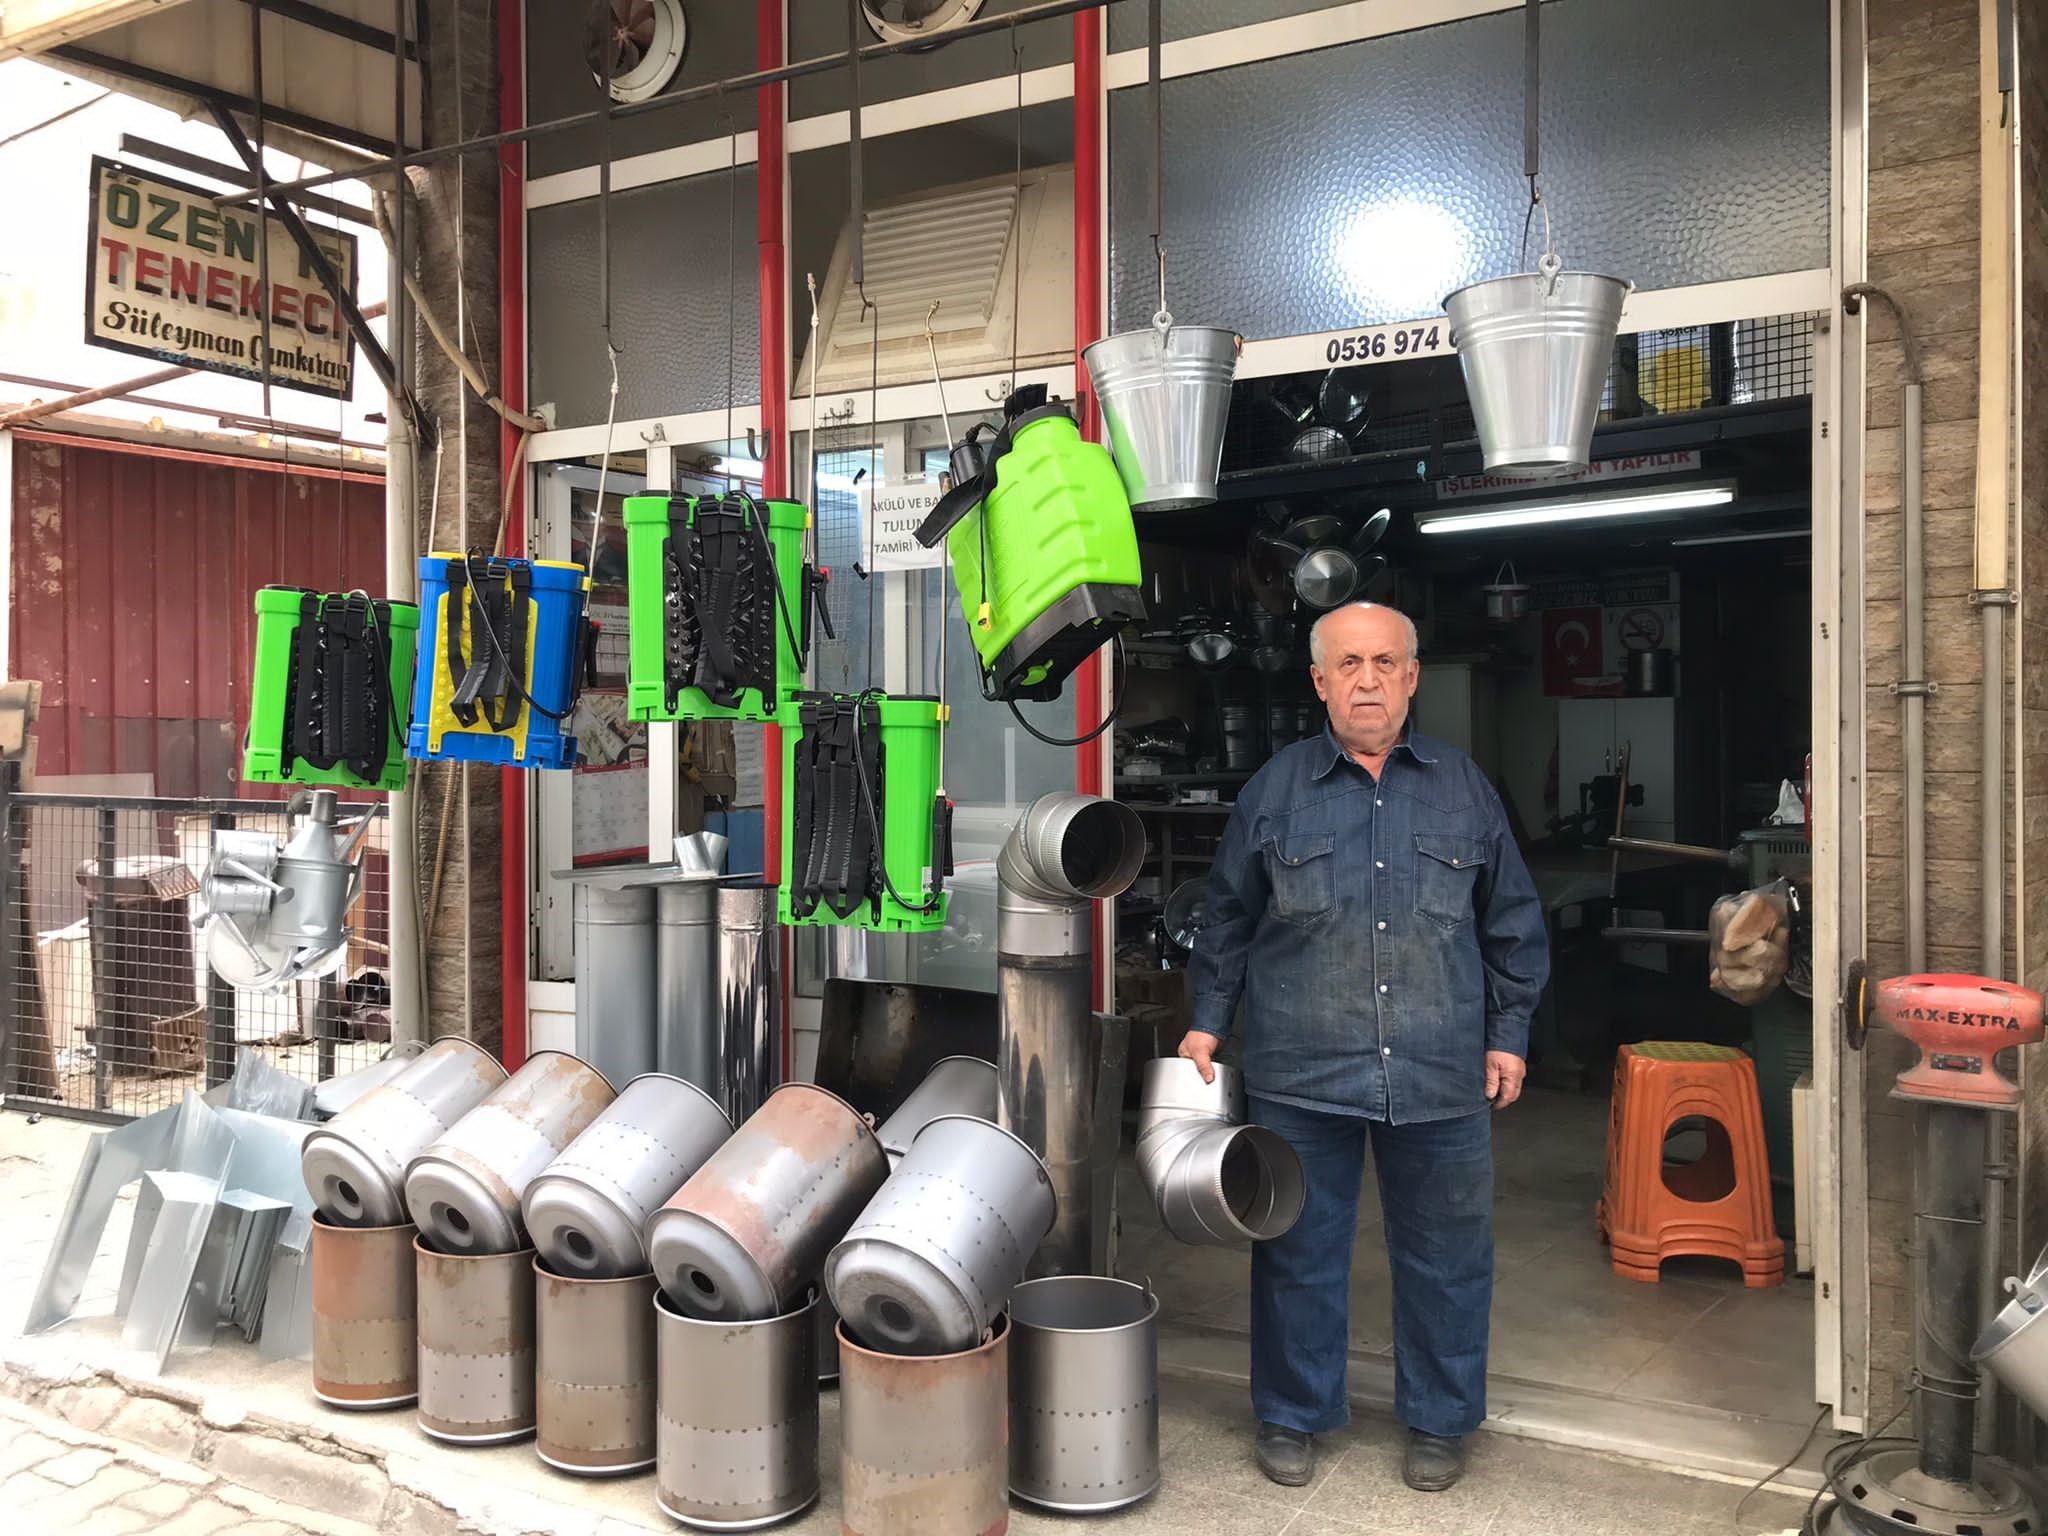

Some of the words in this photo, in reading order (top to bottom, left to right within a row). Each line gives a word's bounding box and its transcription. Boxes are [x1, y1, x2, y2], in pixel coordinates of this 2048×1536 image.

[105, 171, 255, 263] ÖZEN
[102, 301, 245, 358] Süleyman
[1326, 333, 1386, 363] 0536
[1394, 326, 1439, 354] 974
[908, 498, 922, 509] VE
[874, 539, 913, 553] TAMİRİ
[1896, 1007, 2021, 1031] MAX-EXTRA
